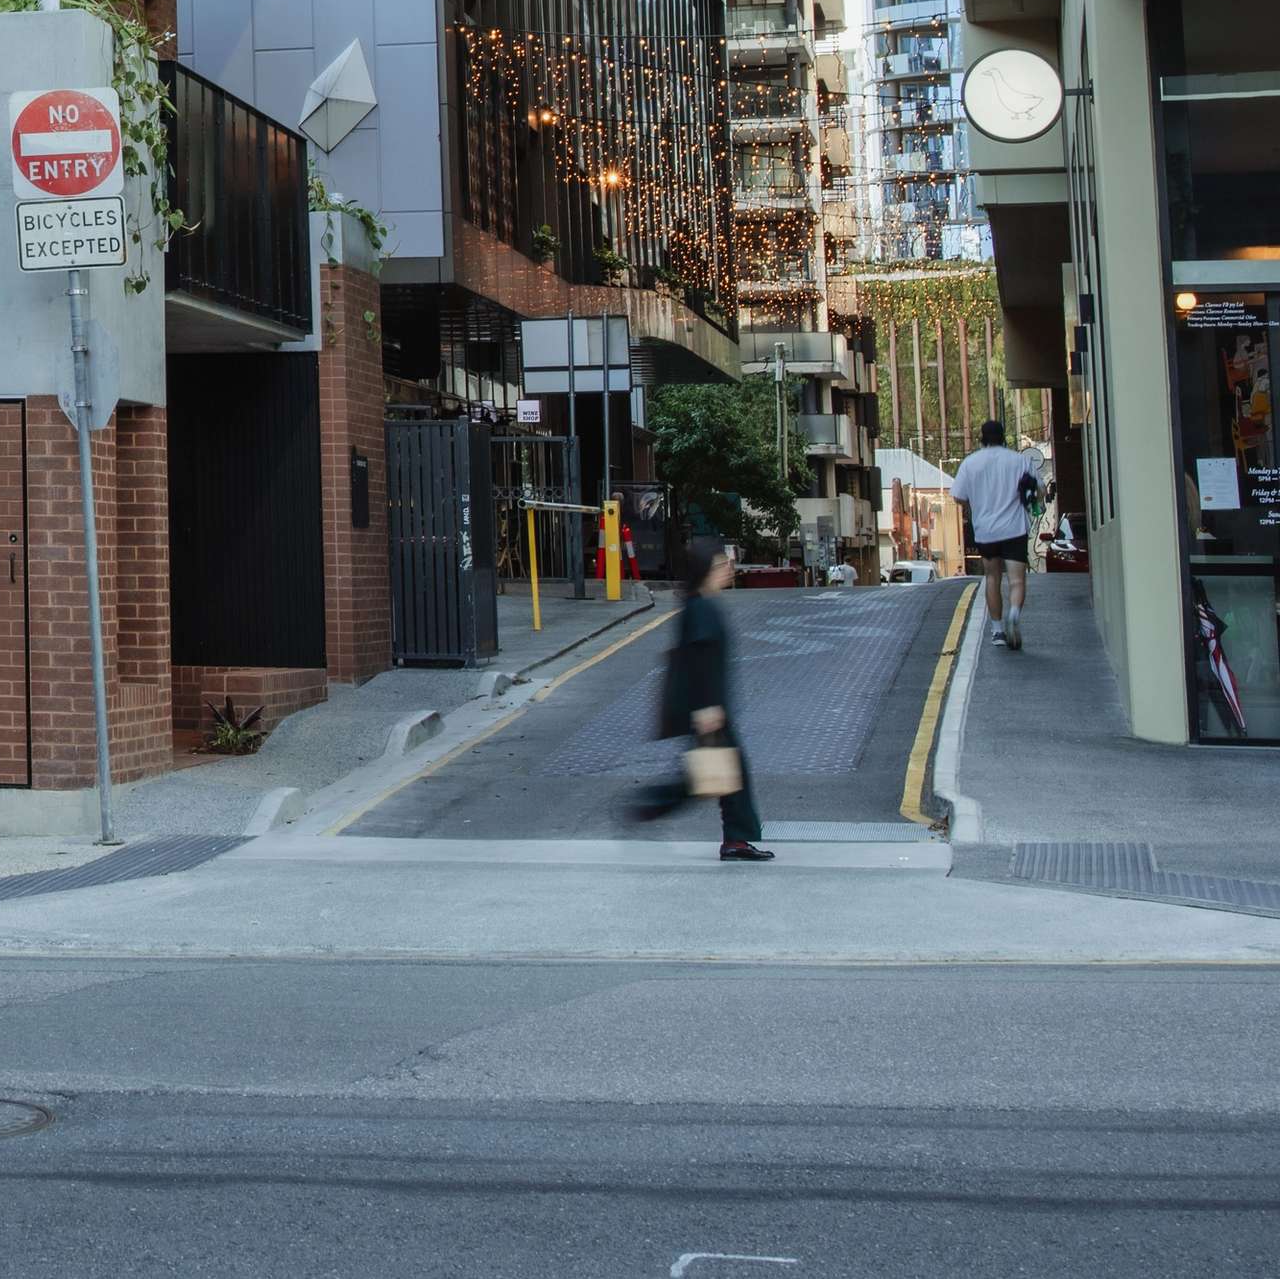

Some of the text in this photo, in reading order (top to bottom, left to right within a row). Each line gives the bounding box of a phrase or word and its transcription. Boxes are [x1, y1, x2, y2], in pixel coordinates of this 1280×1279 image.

[48, 104, 80, 124] NO
[29, 158, 106, 181] ENTRY
[24, 210, 118, 231] BICYCLES
[25, 237, 121, 258] EXCEPTED
[1248, 467, 1272, 476] Monday
[1251, 489, 1270, 498] Friday
